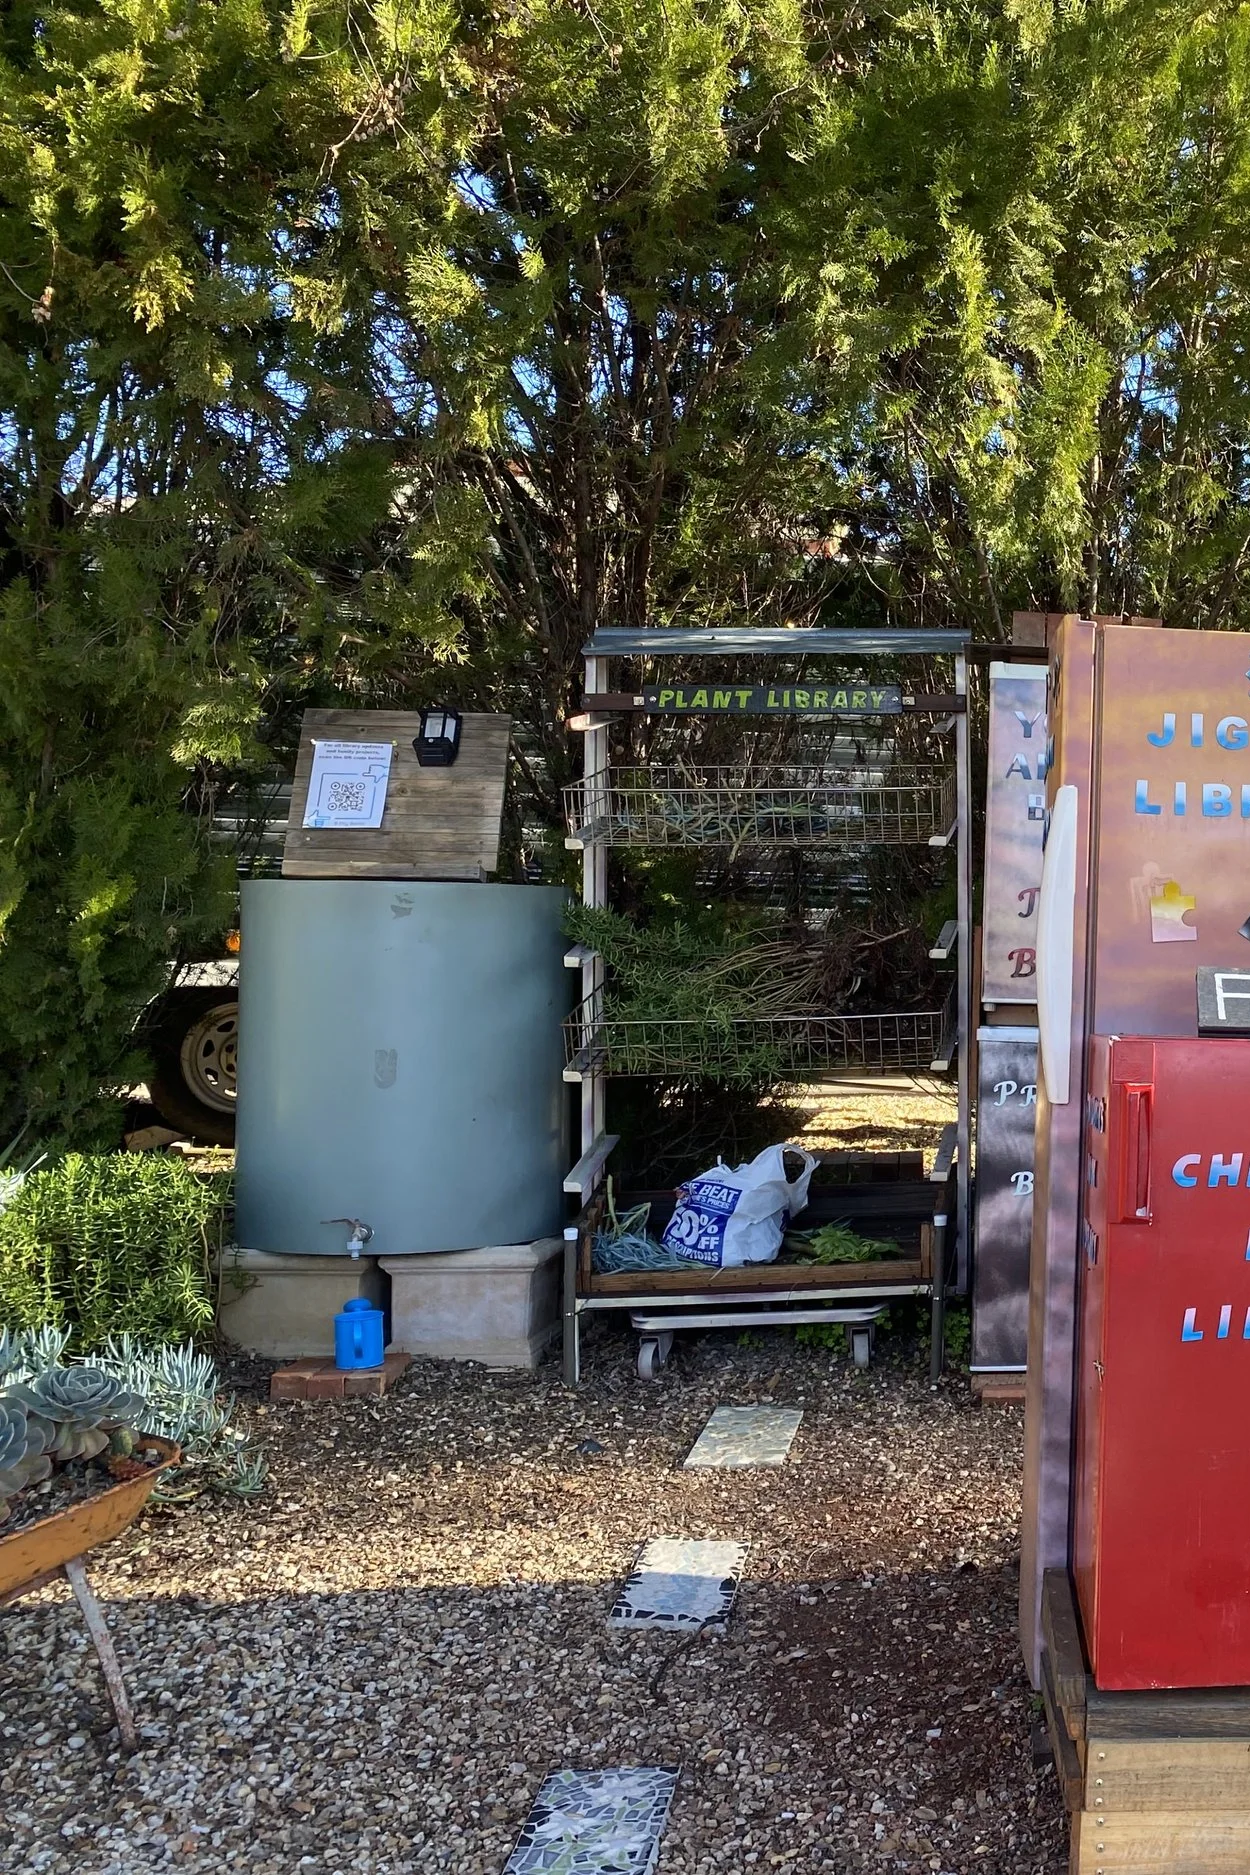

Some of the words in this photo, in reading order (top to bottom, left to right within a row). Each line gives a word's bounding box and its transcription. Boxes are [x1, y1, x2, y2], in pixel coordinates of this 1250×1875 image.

[658, 689, 752, 709] PLANT
[766, 690, 887, 709] LIBRARY
[699, 1185, 740, 1203] BEAT
